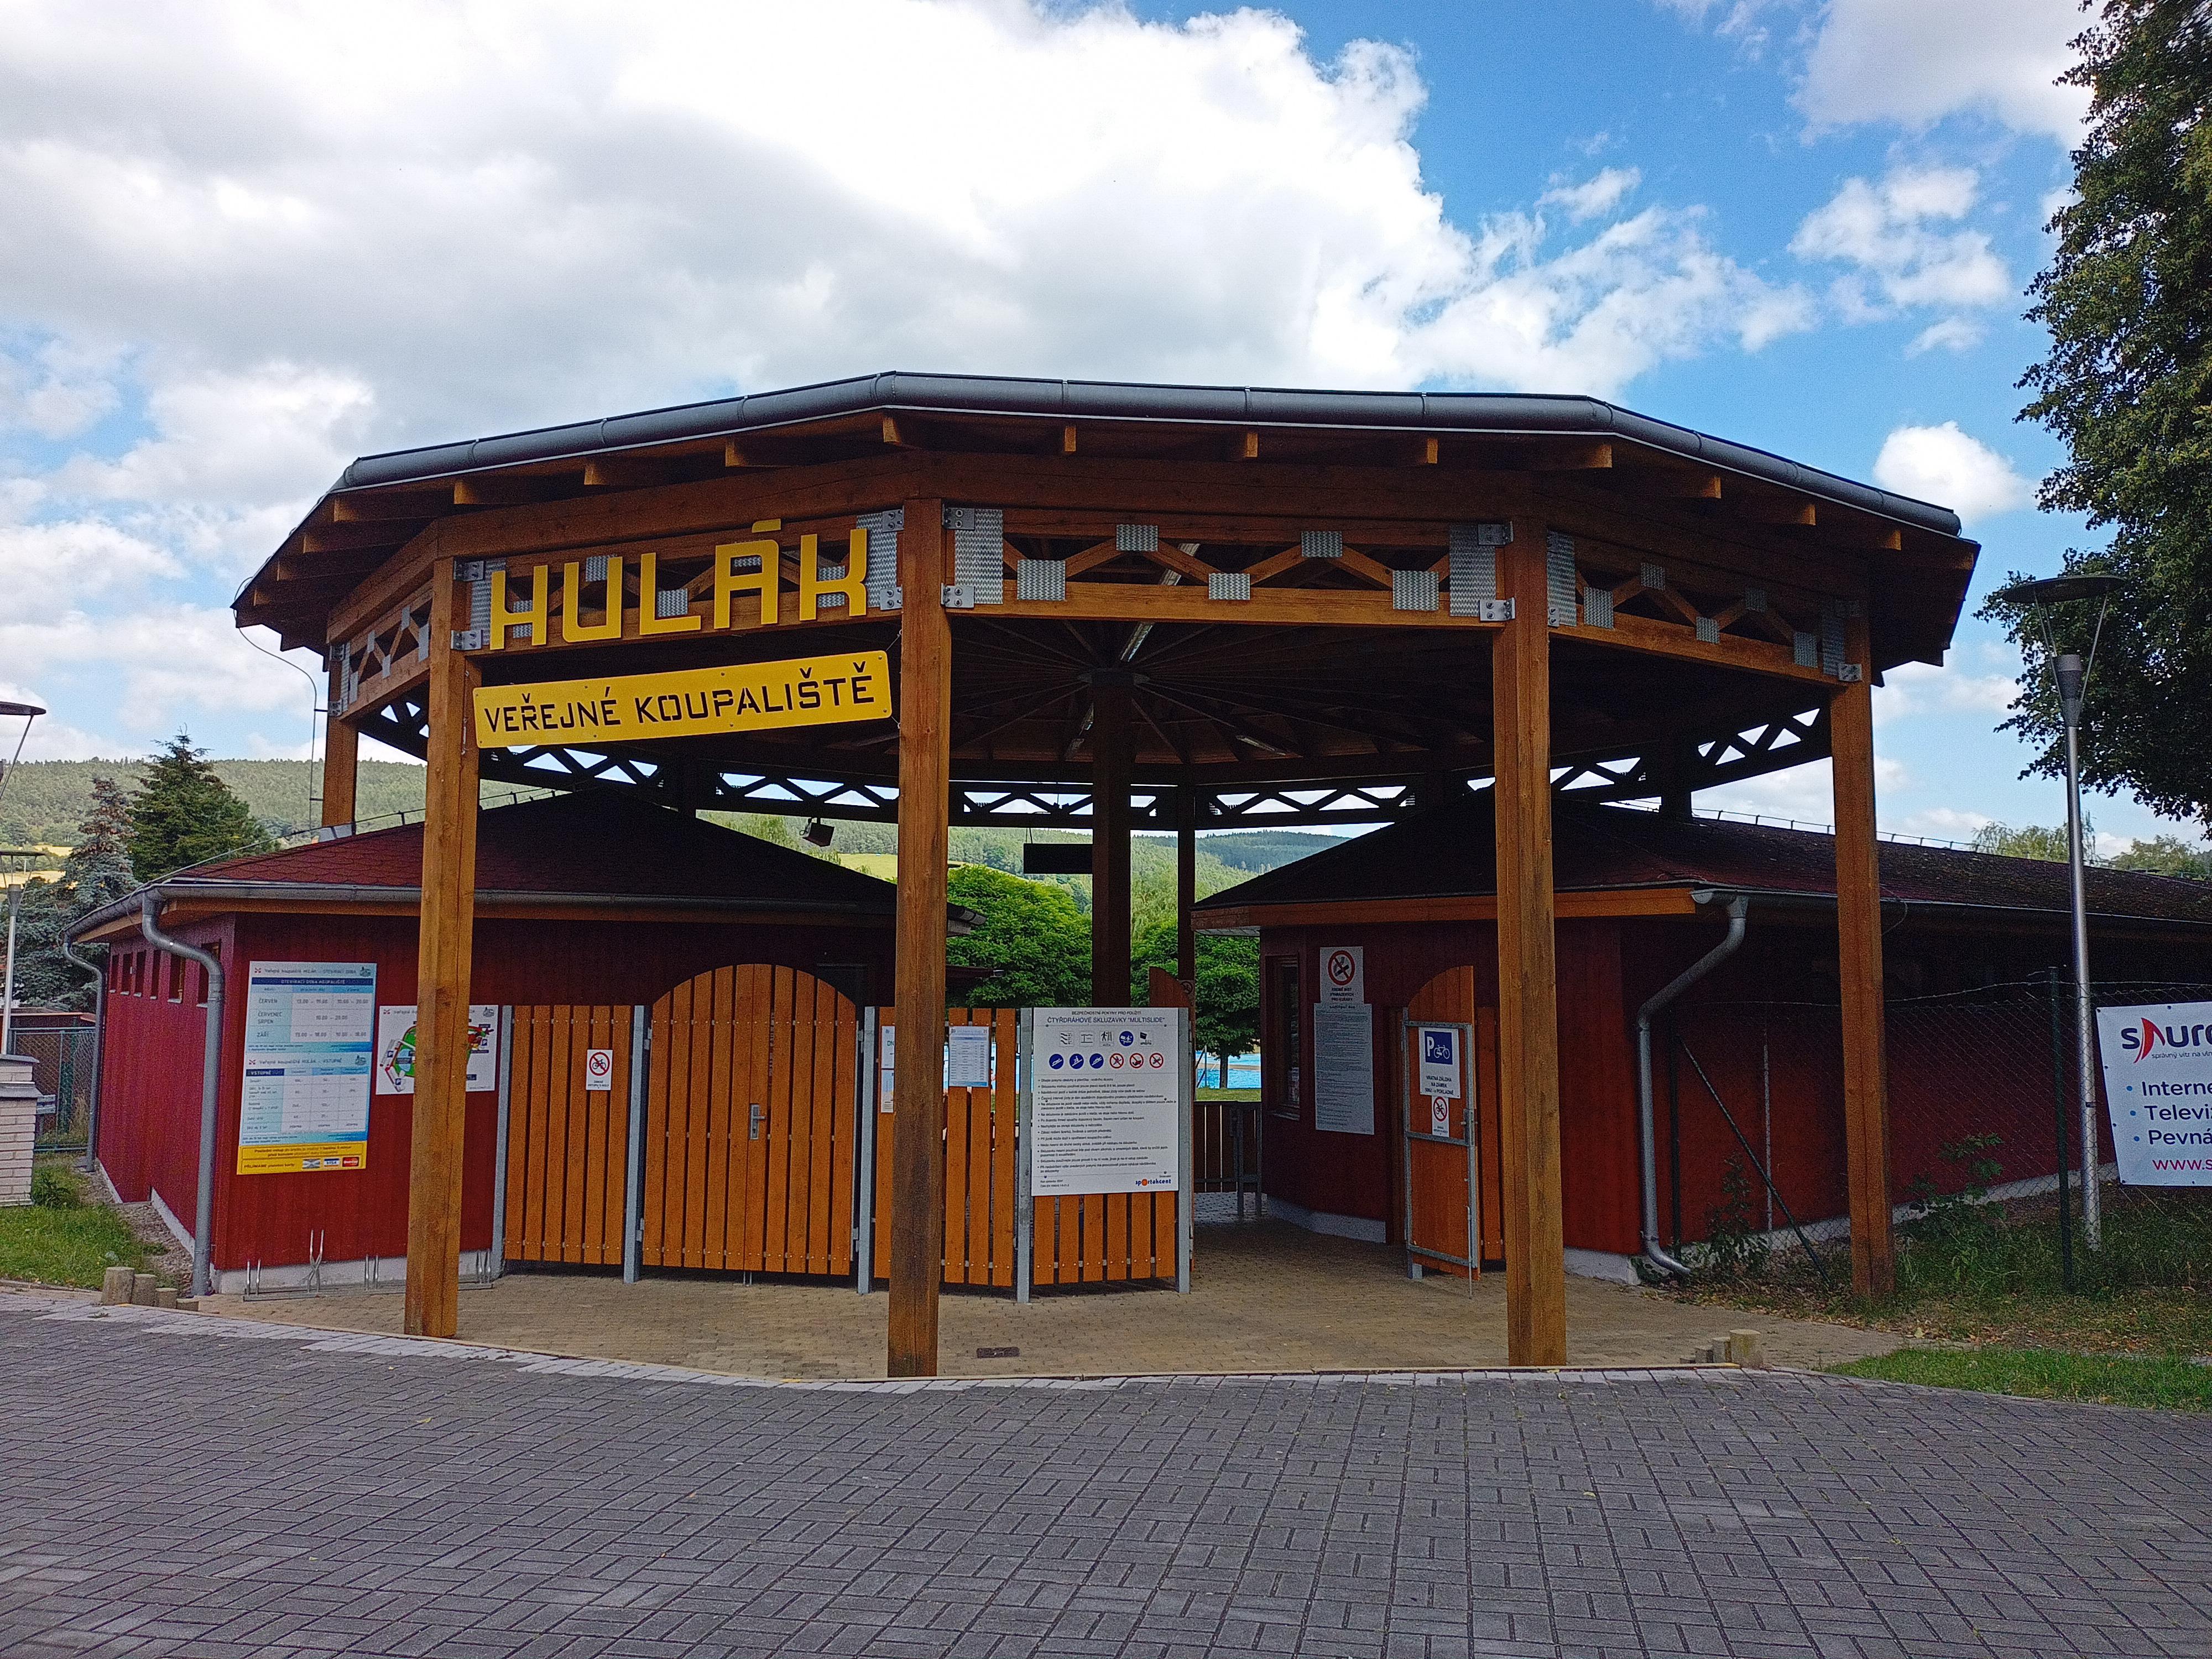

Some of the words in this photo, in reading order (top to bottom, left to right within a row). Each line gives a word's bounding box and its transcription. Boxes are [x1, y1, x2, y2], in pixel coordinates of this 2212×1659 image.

[490, 518, 867, 650] HULÁK
[484, 687, 620, 732] VEŘEJNÉ
[635, 661, 874, 723] KOUPALIŠTĚ
[1427, 1036, 1434, 1057] P
[2143, 1103, 2212, 1120] Televi
[2148, 1128, 2212, 1145] Pevná
